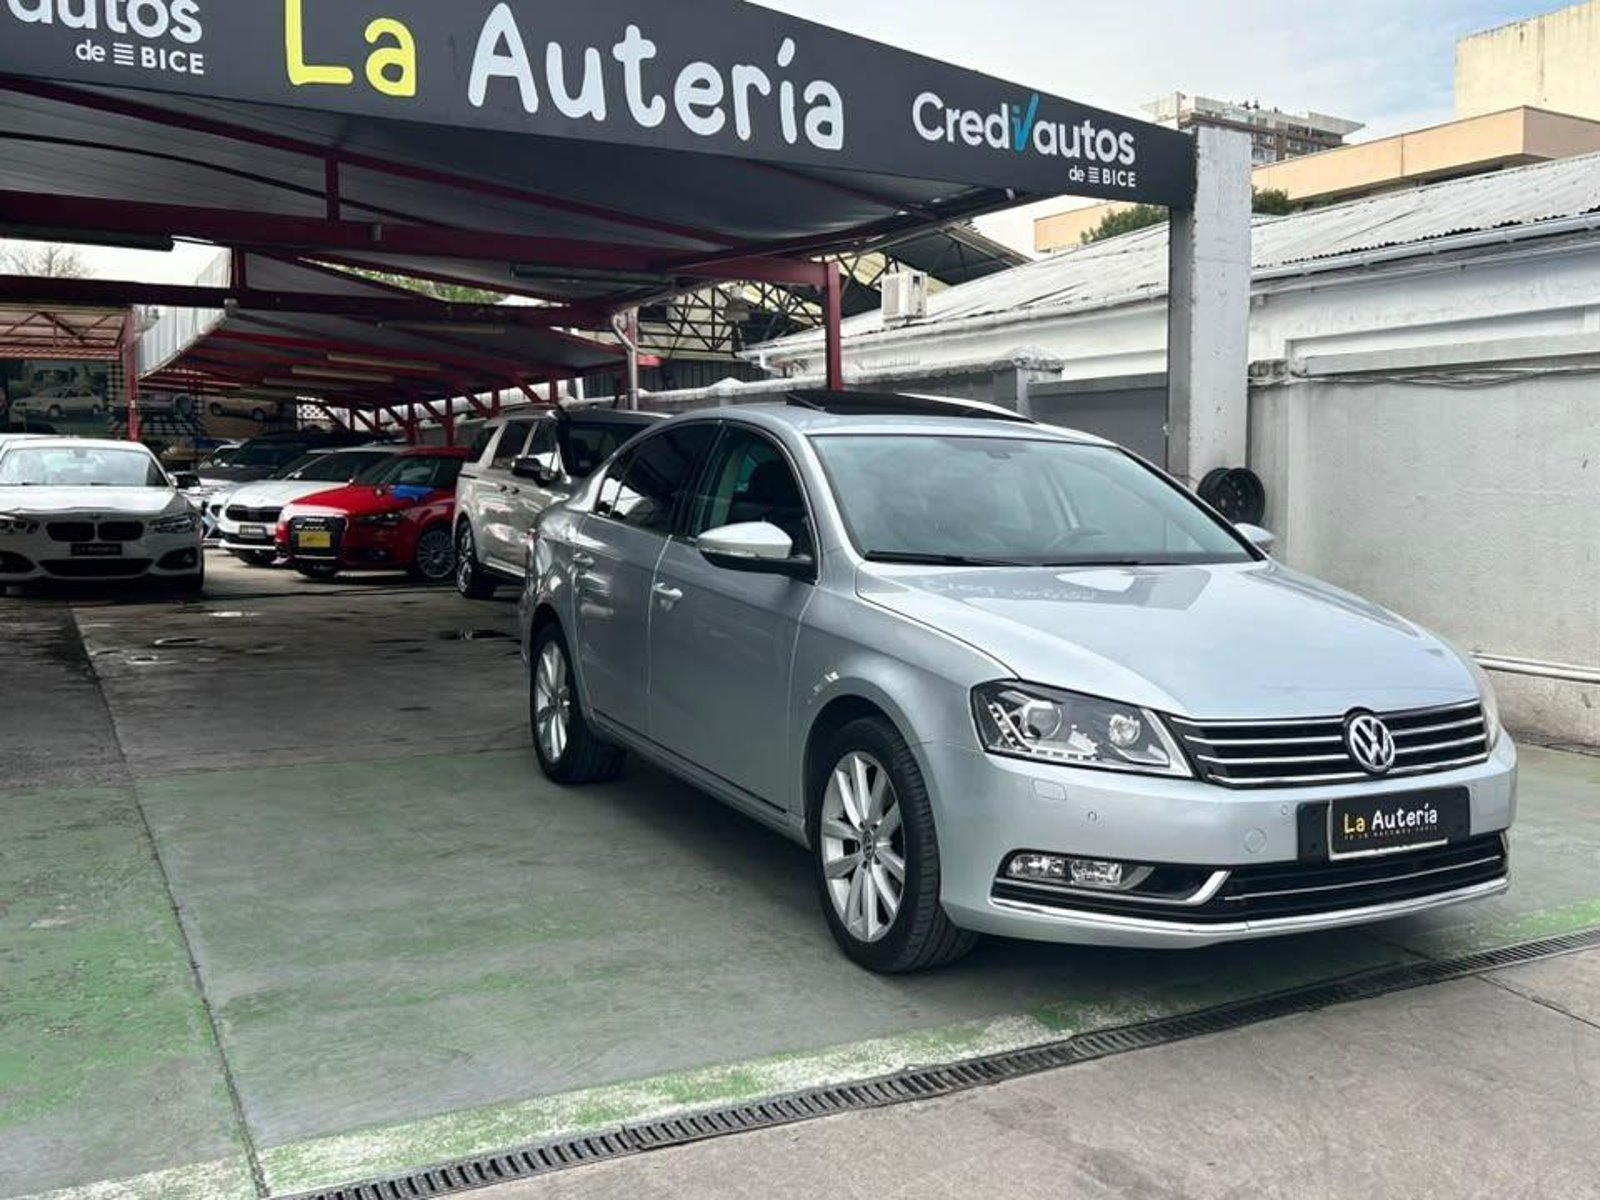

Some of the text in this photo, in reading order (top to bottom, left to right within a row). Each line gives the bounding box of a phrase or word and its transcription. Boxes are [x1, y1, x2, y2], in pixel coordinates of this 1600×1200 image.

[75, 39, 205, 75] de BICE
[285, 0, 844, 150] La Autería
[1068, 164, 1137, 188] de BICE
[1344, 812, 1366, 834] La
[1371, 802, 1437, 831] Autería
